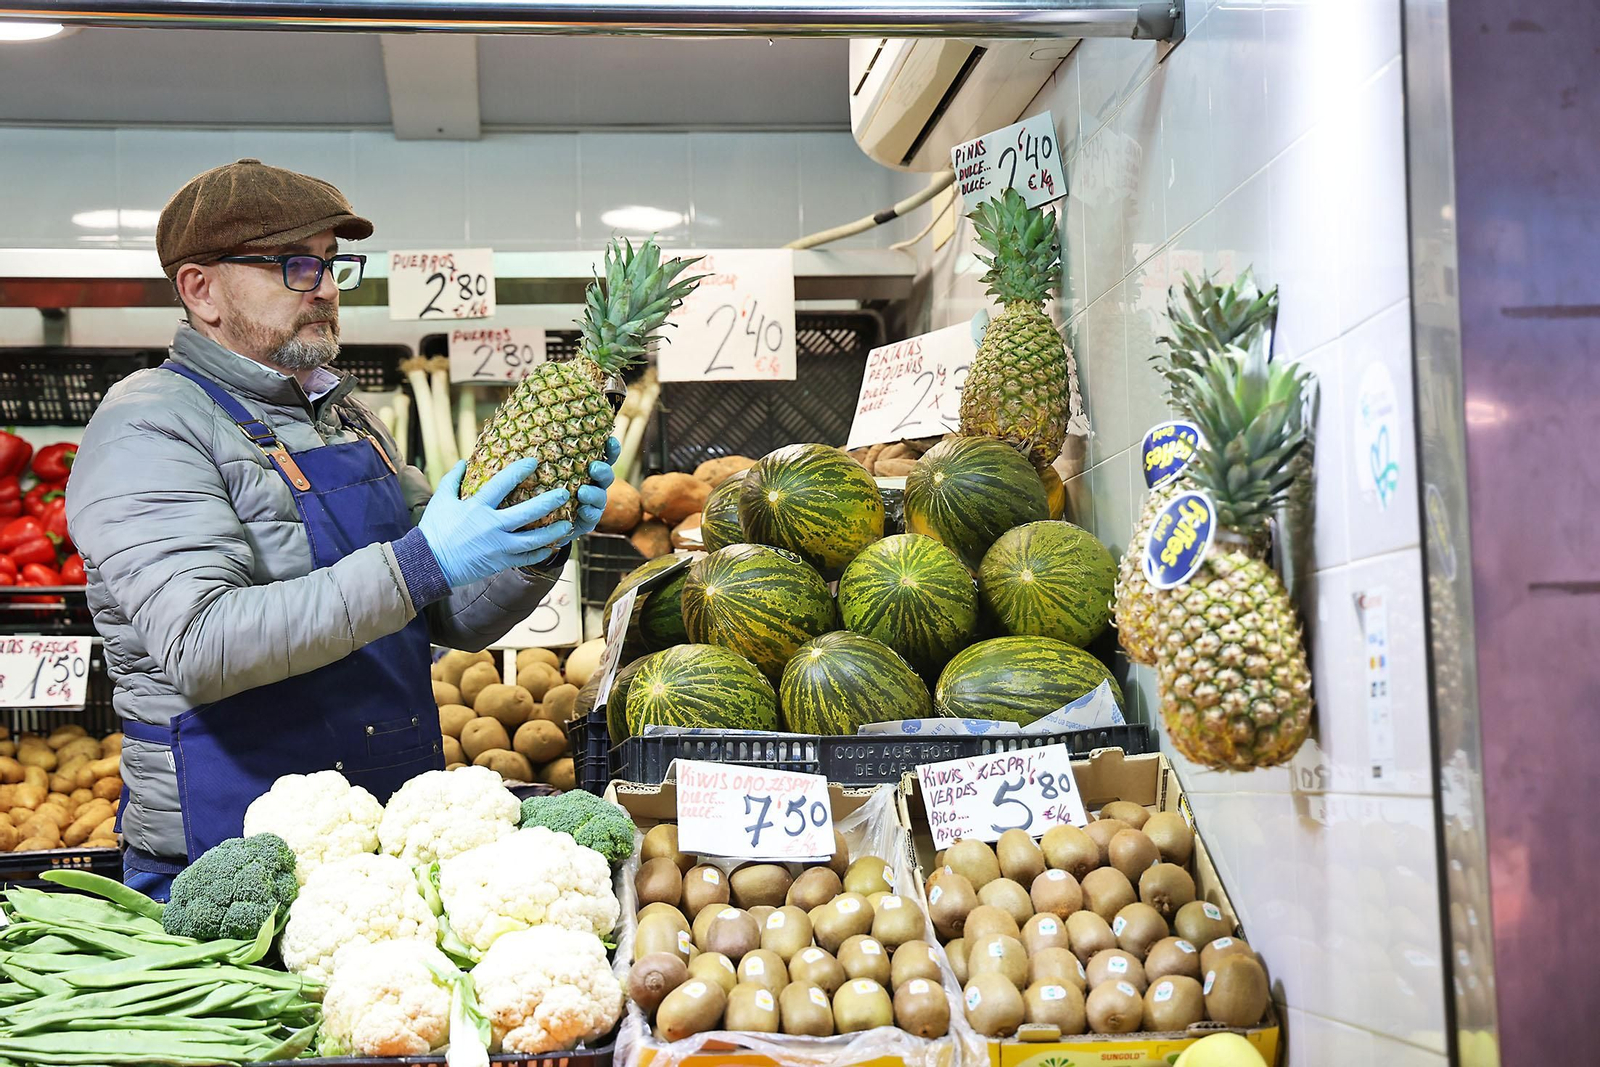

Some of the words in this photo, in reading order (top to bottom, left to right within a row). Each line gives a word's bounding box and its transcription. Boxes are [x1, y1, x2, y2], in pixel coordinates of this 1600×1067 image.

[1028, 174, 1038, 190] €
[1040, 168, 1054, 196] Kg
[393, 253, 456, 272] PUERROS
[419, 268, 488, 318] 2'80
[453, 328, 511, 343] PUERROS
[704, 293, 783, 374] 2'40
[472, 343, 535, 377] 2'80
[869, 338, 923, 368] BATATAS
[855, 763, 874, 776] DE
[930, 781, 978, 808] VERDES
[743, 792, 828, 849] 7'50
